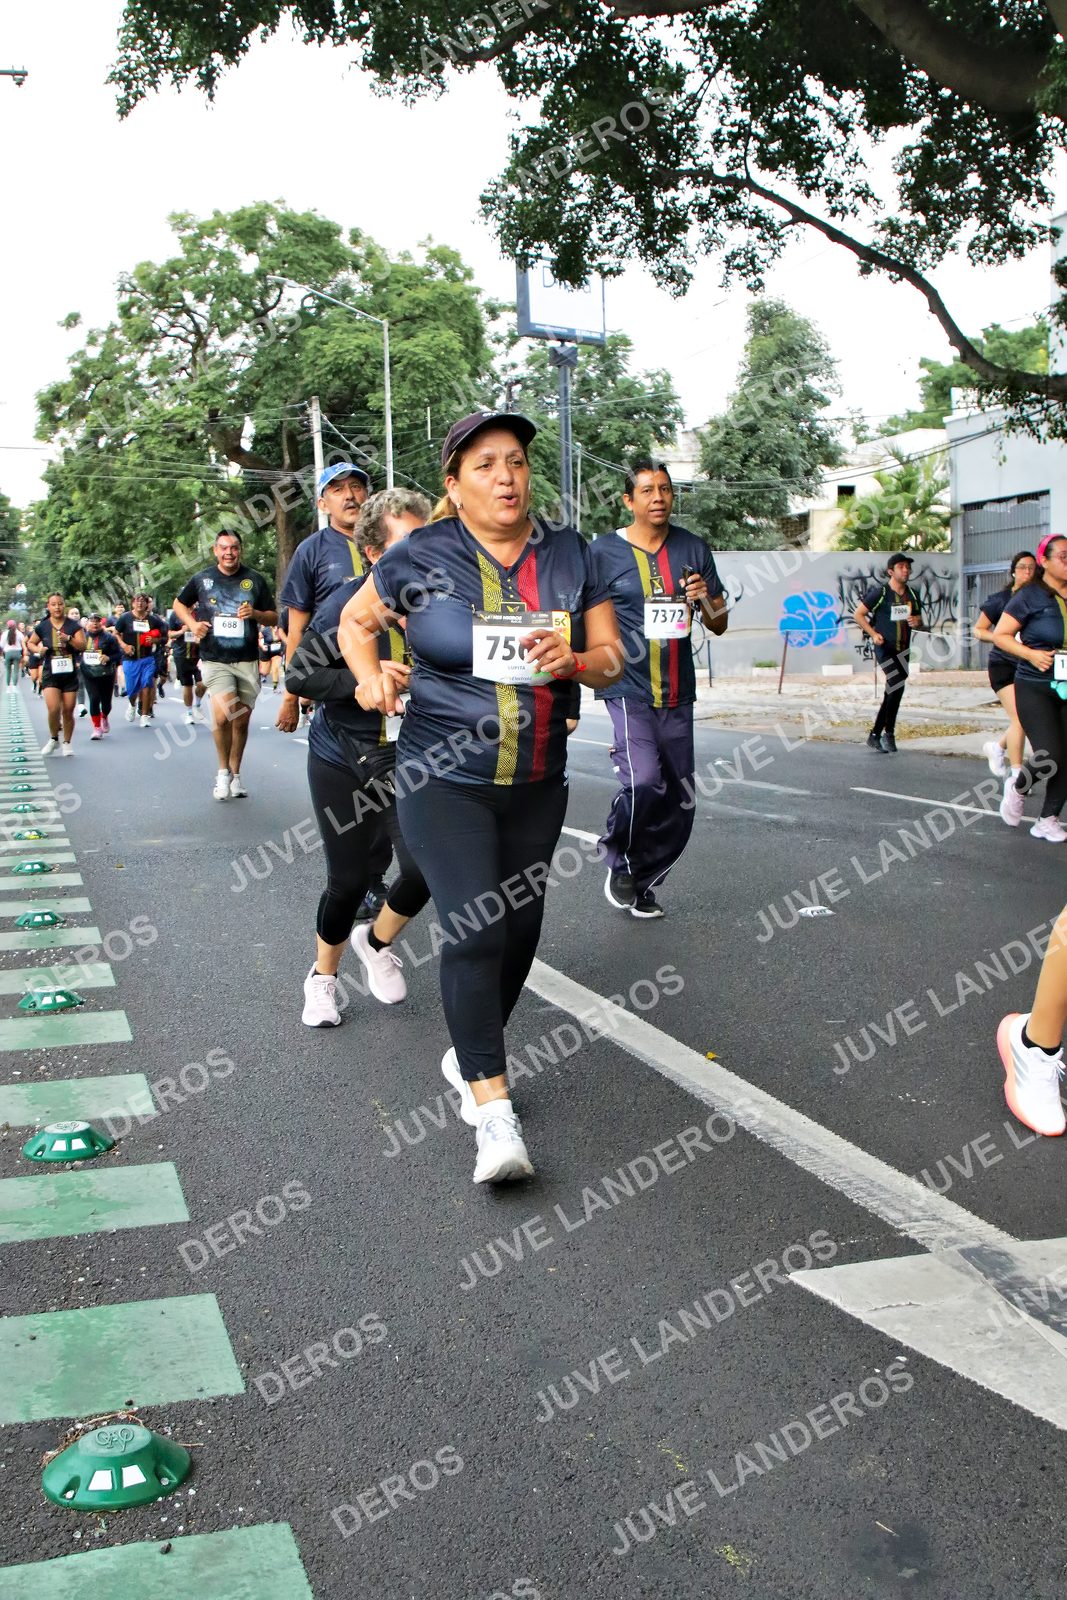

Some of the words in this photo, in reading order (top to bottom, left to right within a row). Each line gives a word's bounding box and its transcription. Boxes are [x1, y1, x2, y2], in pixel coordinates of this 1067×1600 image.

[651, 609, 684, 623] 7372
[222, 620, 238, 630] 688
[555, 618, 567, 627] 5K
